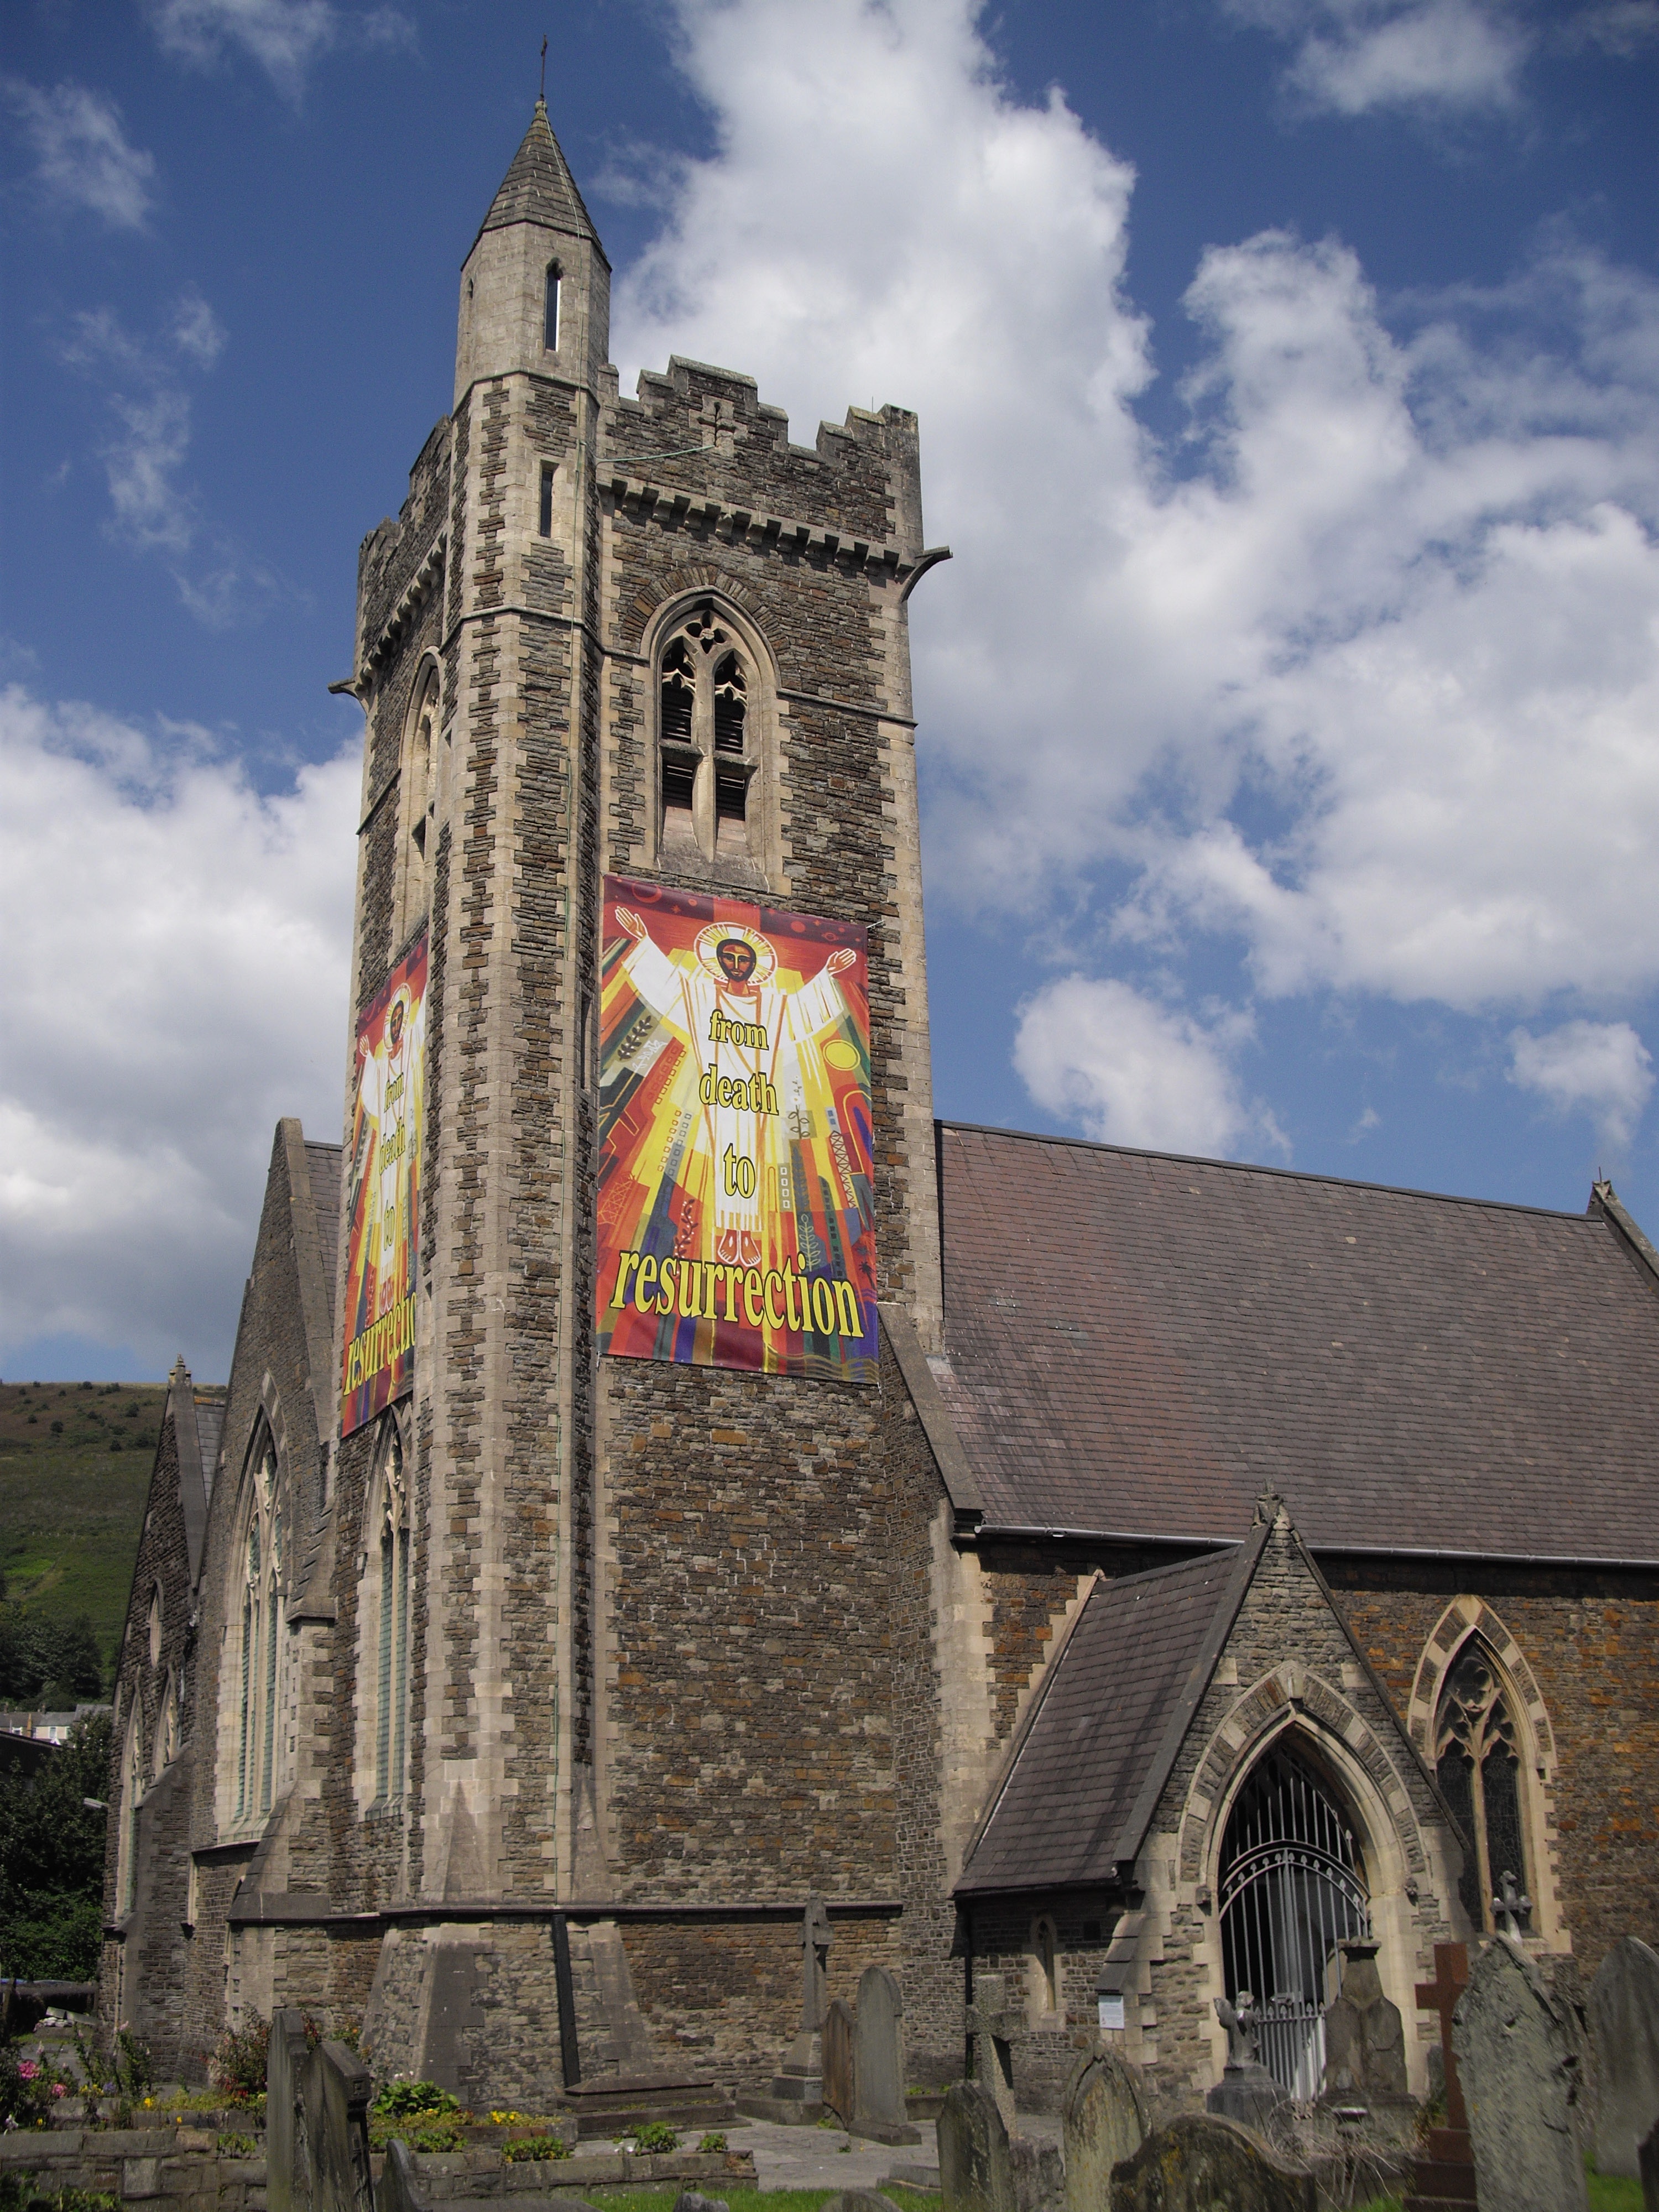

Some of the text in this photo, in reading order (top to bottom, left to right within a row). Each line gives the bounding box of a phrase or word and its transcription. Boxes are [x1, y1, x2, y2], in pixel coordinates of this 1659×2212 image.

[708, 1009, 769, 1050] from
[384, 1072, 404, 1113] from
[699, 1063, 779, 1115] death
[379, 1116, 405, 1176] death
[723, 1142, 755, 1198] to
[383, 1199, 394, 1251] to
[610, 1250, 864, 1337] resurrection
[343, 1277, 416, 1396] resurrectio
